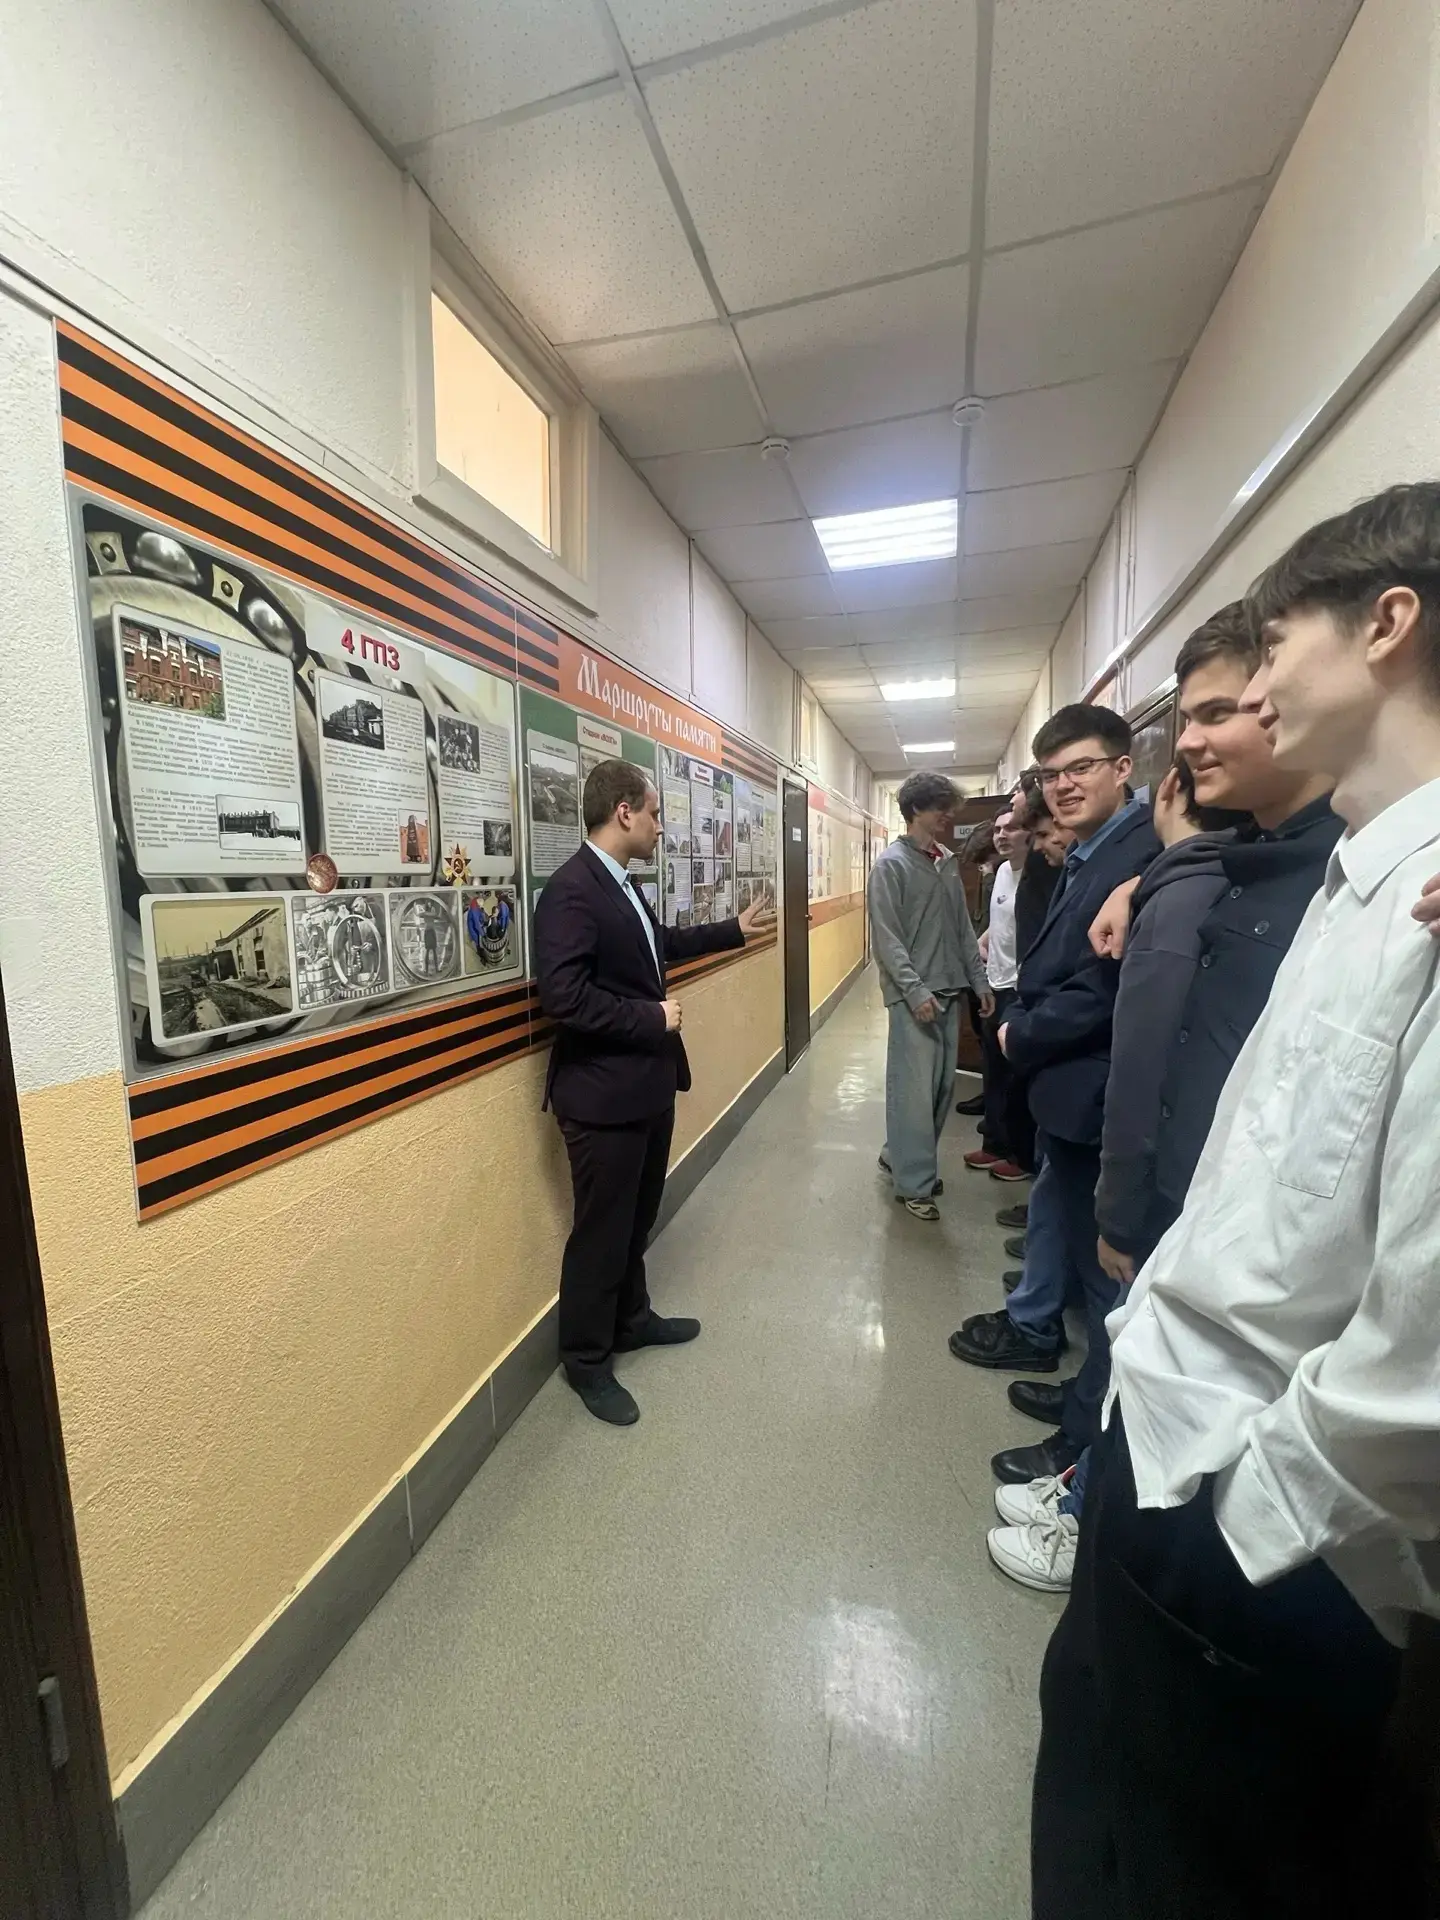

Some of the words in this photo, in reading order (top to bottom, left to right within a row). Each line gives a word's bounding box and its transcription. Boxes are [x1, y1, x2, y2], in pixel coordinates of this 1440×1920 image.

[341, 629, 355, 655] 4
[361, 634, 400, 671] ГПЗ
[577, 653, 671, 735] Маршруты
[675, 717, 716, 753] памяти
